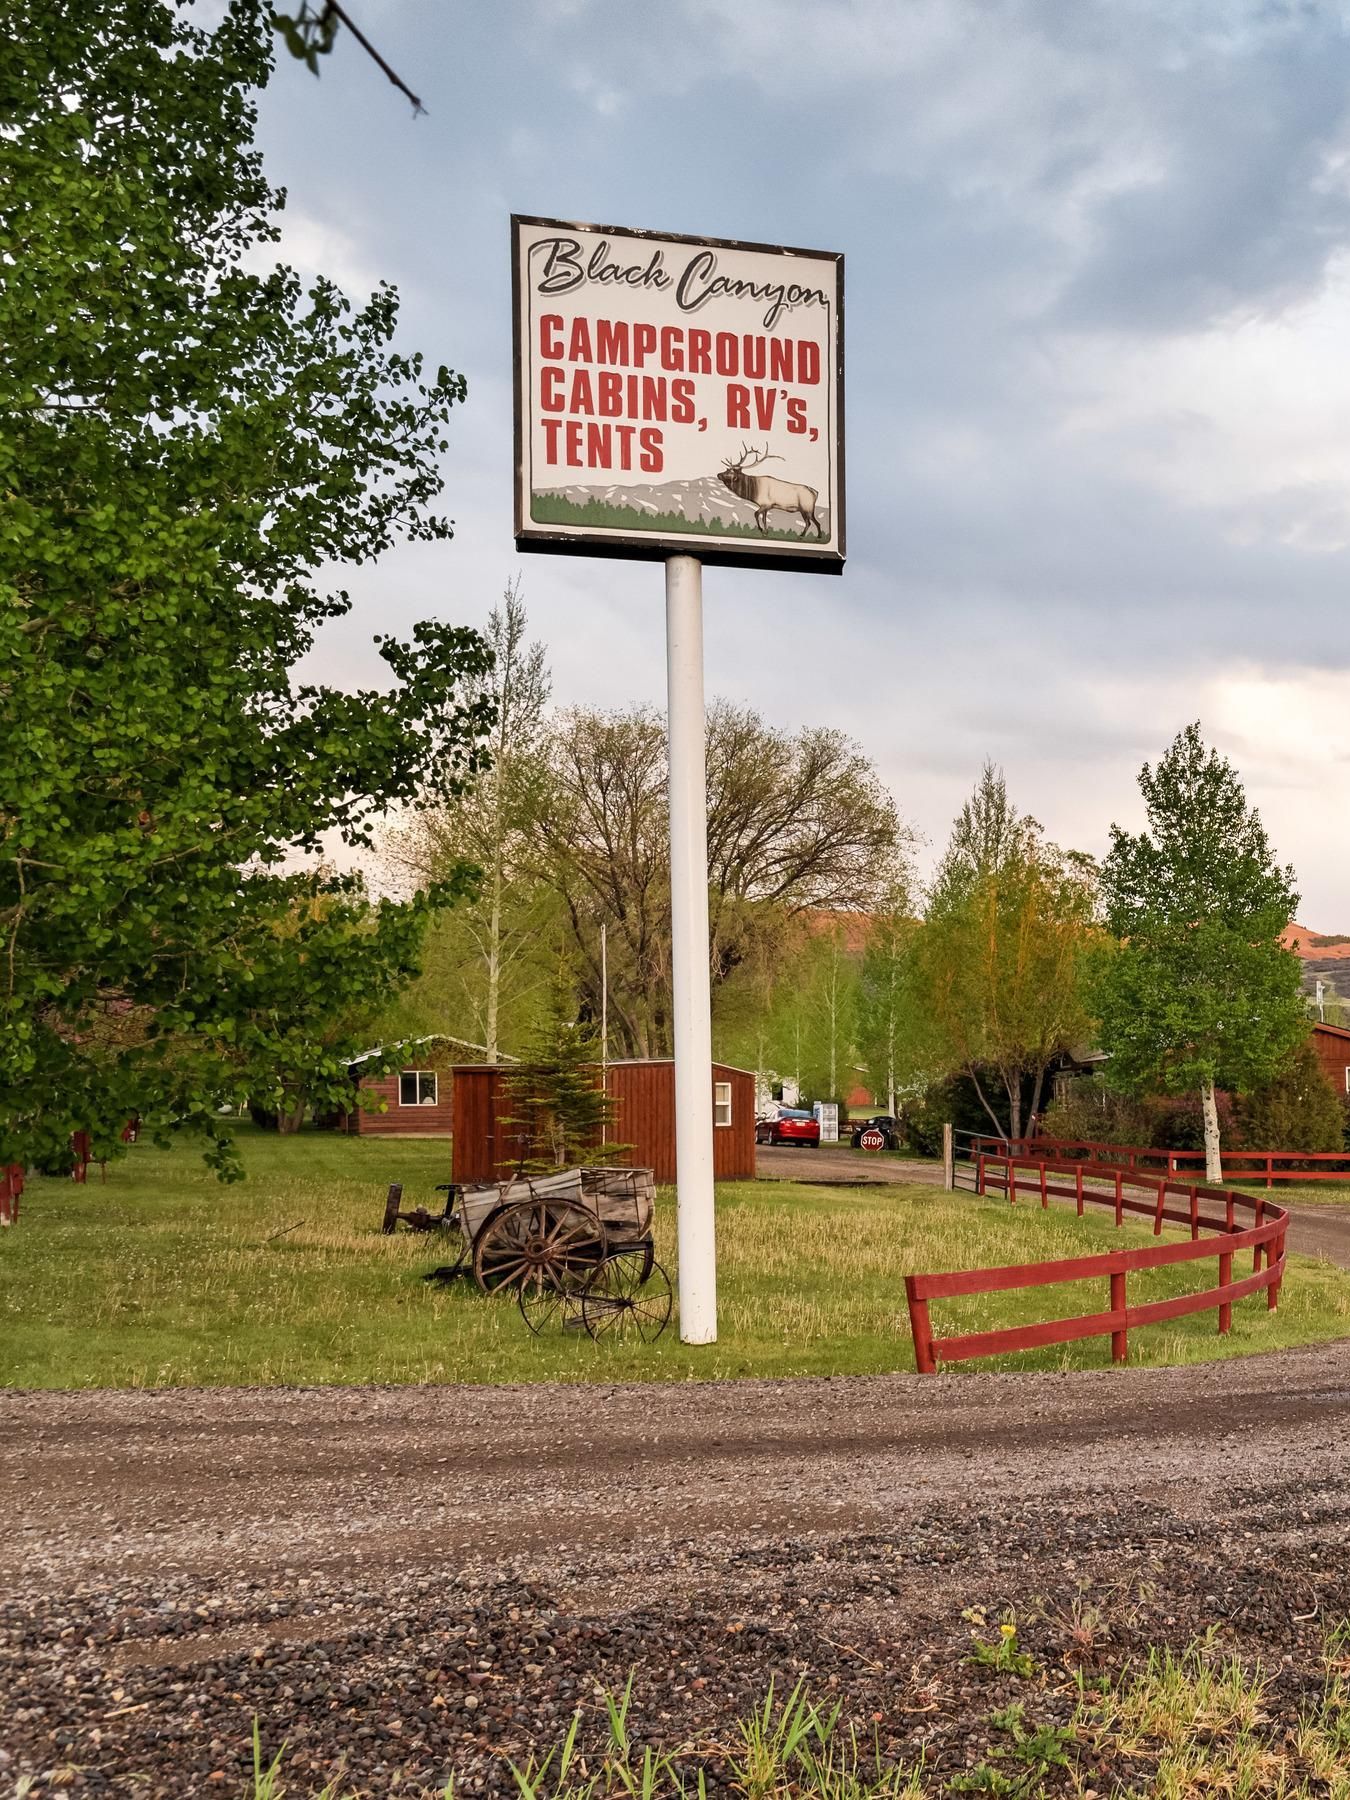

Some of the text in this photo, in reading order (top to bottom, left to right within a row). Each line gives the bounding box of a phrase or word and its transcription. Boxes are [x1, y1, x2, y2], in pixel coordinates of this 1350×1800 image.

[530, 238, 829, 329] Black Canyon
[540, 314, 821, 385] CAMPGROUND
[540, 366, 819, 442] CABINS, RV's,
[541, 418, 664, 473] TENTS
[863, 1136, 882, 1145] STOP
